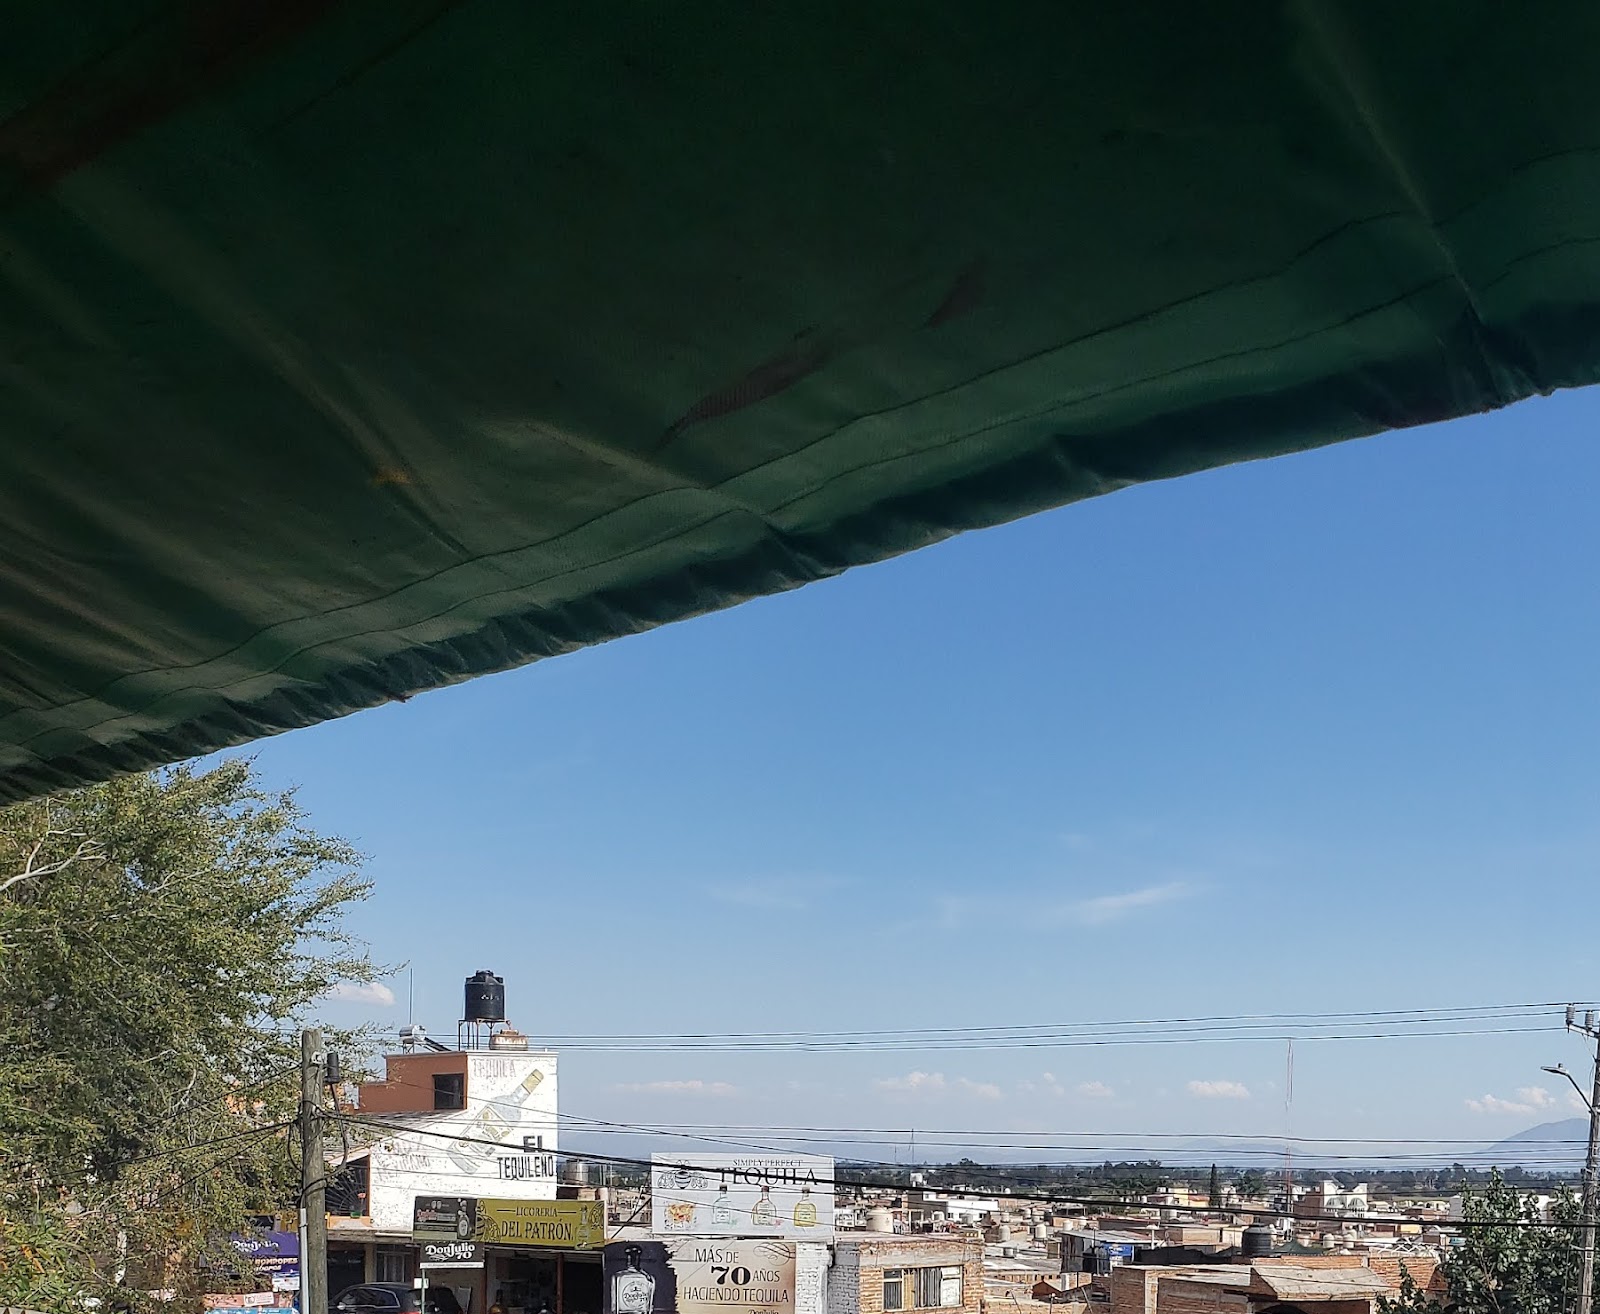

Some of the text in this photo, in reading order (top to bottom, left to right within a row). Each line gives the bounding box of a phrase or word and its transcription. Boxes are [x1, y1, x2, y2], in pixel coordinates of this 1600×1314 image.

[501, 1220, 522, 1239] DEL
[455, 1251, 473, 1260] 70
[694, 1246, 739, 1263] MÁS DE
[711, 1266, 781, 1286] 70 AÑOS
[683, 1286, 789, 1303] HACIENDO TEQUILA
